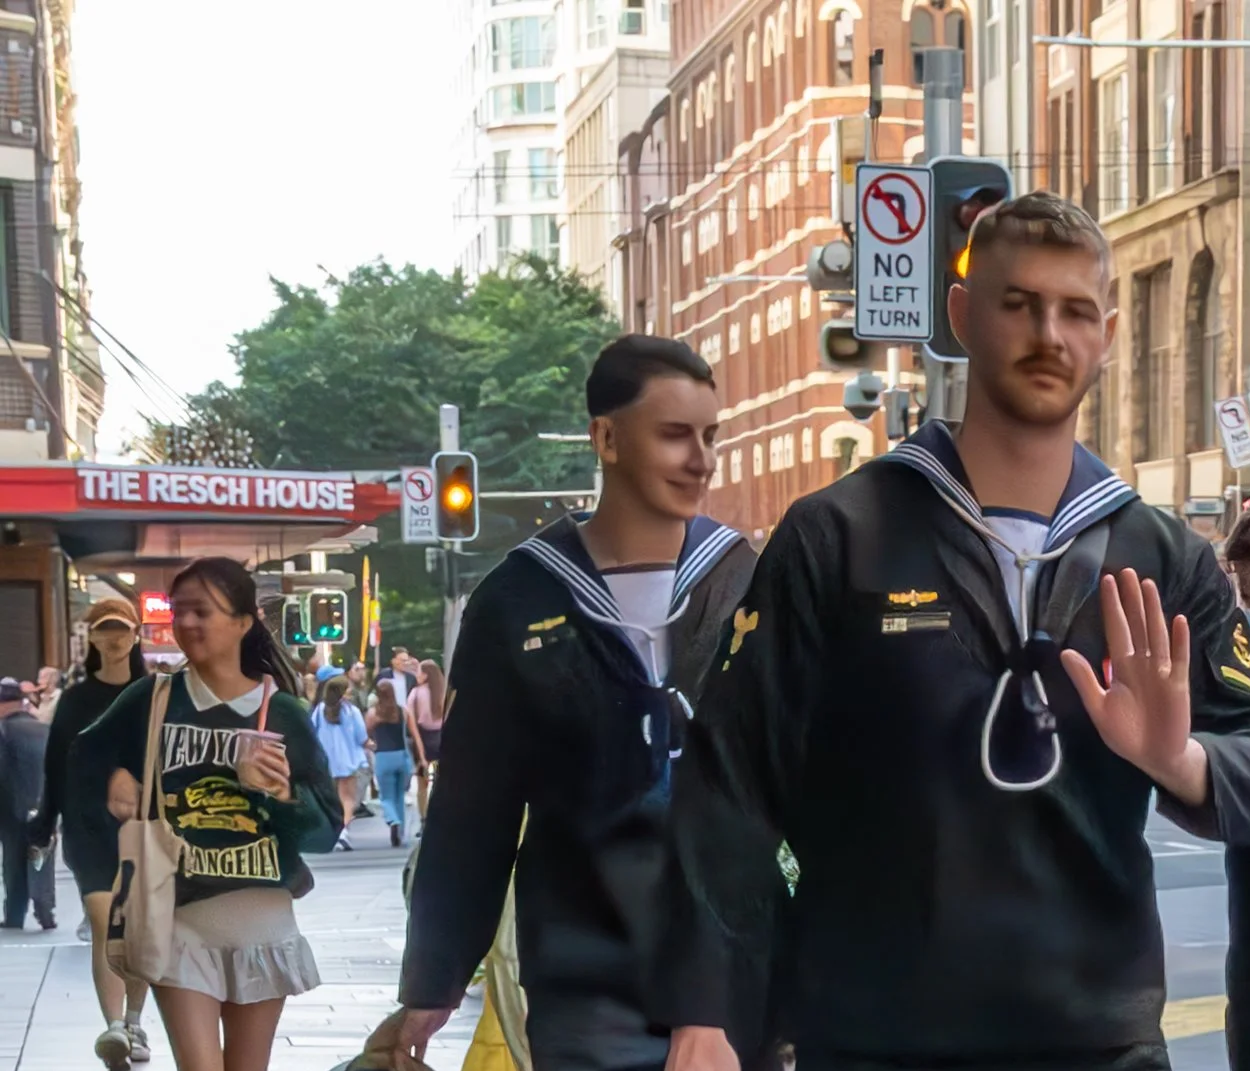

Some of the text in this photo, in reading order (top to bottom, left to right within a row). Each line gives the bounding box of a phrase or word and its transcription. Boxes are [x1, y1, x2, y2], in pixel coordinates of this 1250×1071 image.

[874, 253, 913, 278] NO
[870, 285, 919, 303] LEFT
[866, 309, 920, 327] TURN
[78, 469, 355, 511] THE RESCH HOUSE
